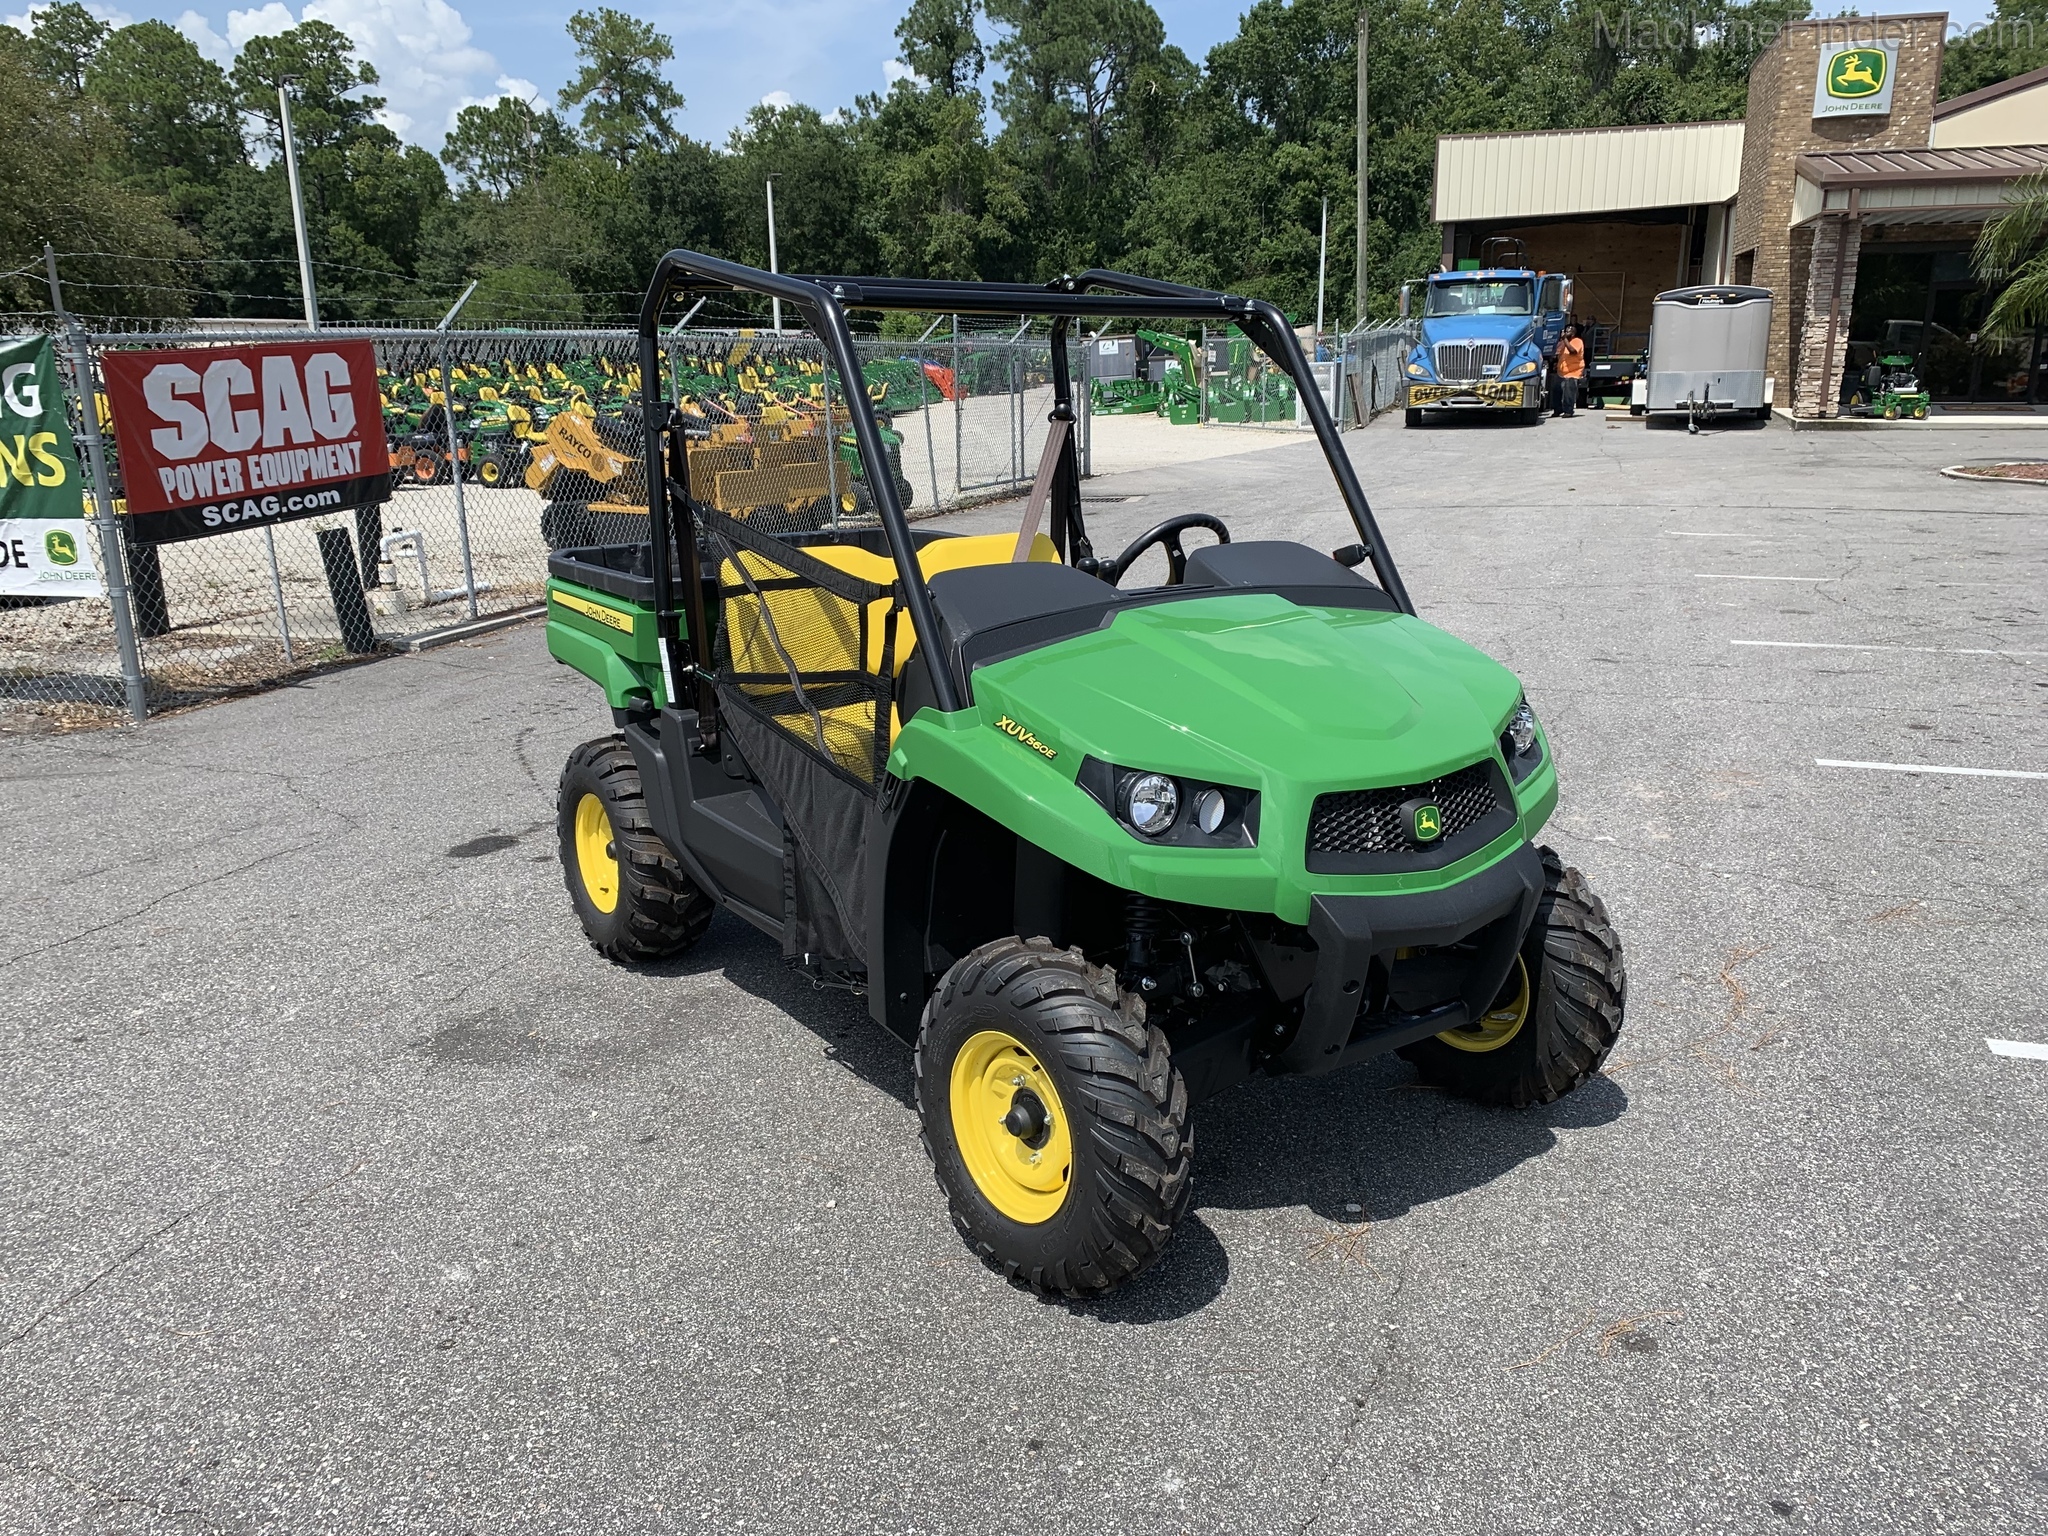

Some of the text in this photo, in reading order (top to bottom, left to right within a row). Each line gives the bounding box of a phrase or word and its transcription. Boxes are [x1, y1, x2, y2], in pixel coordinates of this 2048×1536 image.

[1822, 102, 1883, 113] JOHN DEERE
[142, 352, 357, 461] SCAG
[558, 427, 592, 459] RAYCO
[158, 441, 362, 504] POWER EQUIPMENT
[201, 489, 341, 527] SCAG.com
[38, 570, 97, 581] JOHN DEERE
[585, 605, 621, 628] JOHN DEERE
[993, 713, 1059, 760] XUV560E
